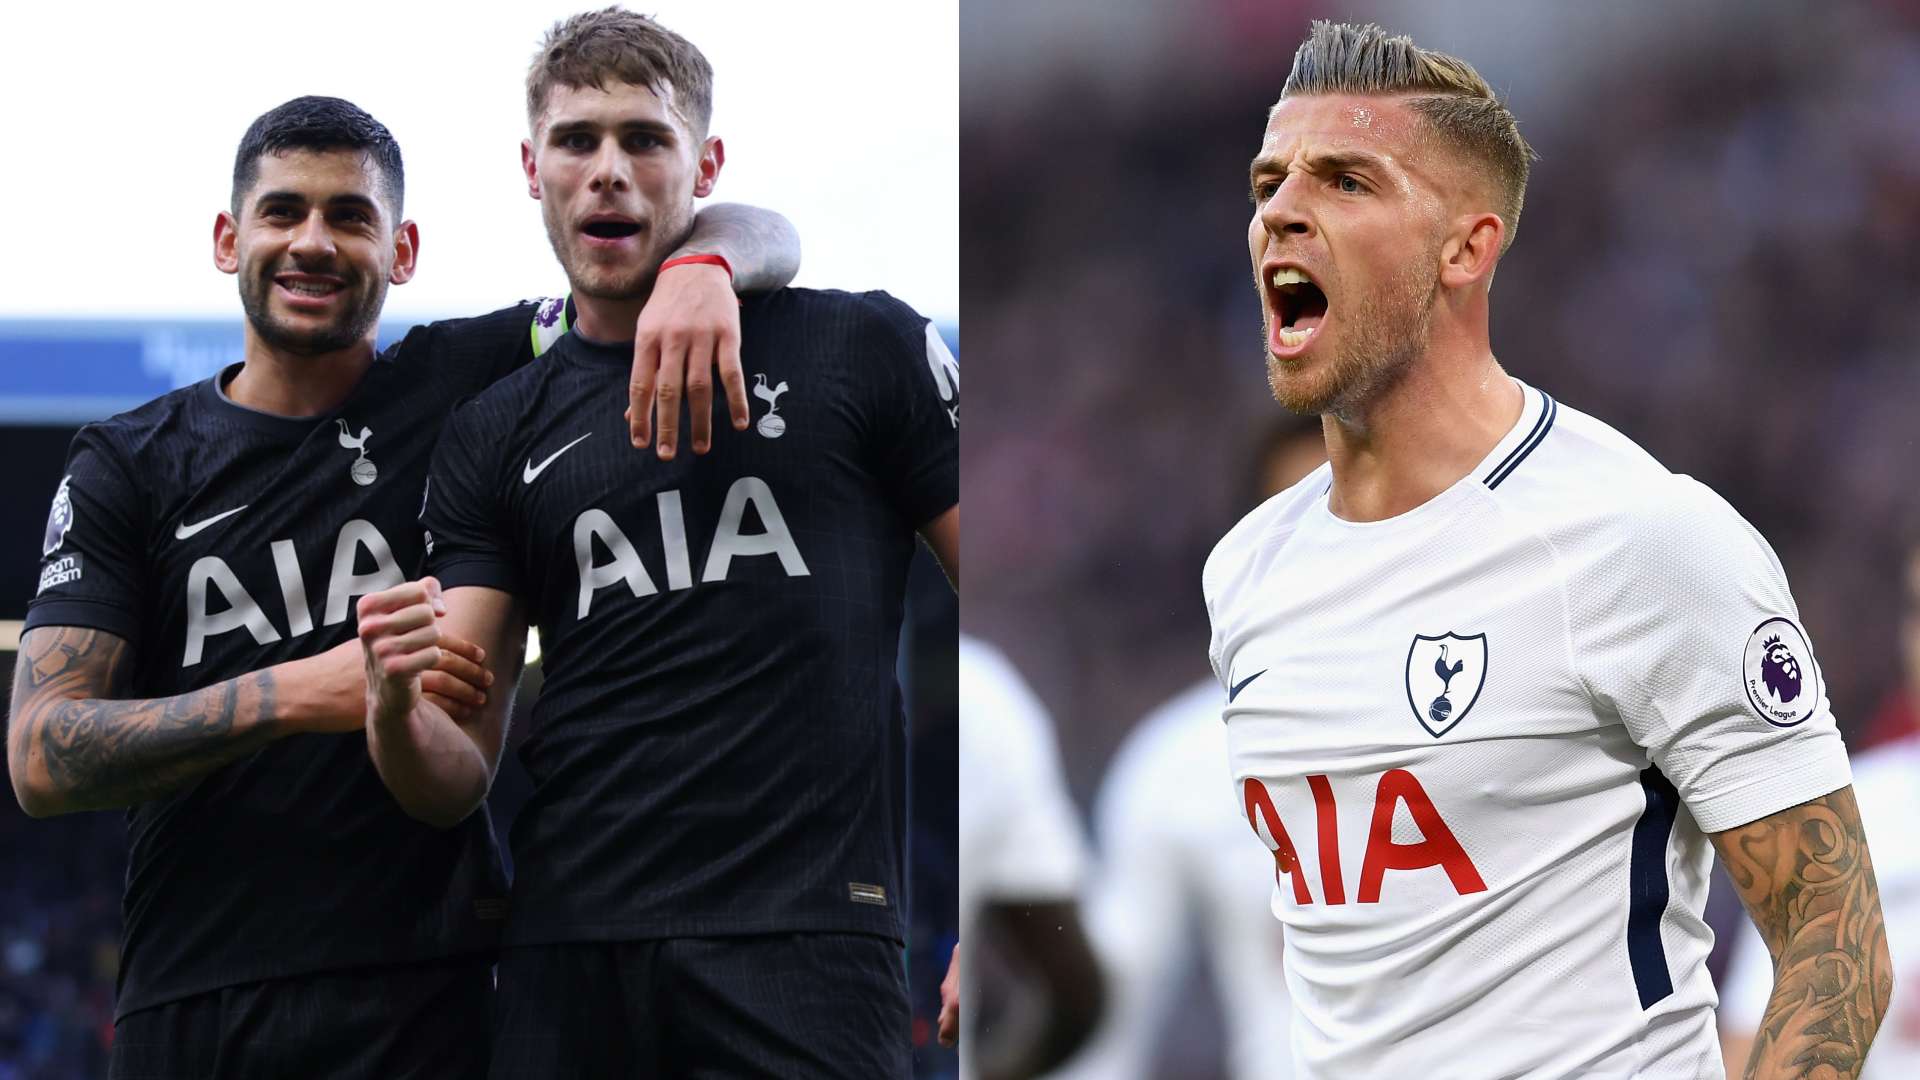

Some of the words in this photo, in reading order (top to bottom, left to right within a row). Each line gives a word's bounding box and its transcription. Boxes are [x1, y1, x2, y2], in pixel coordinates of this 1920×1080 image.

[182, 519, 407, 668] AIA
[573, 477, 811, 620] AIA
[1750, 680, 1768, 710] Premier
[1770, 706, 1796, 720] League
[1243, 768, 1489, 906] AIA
